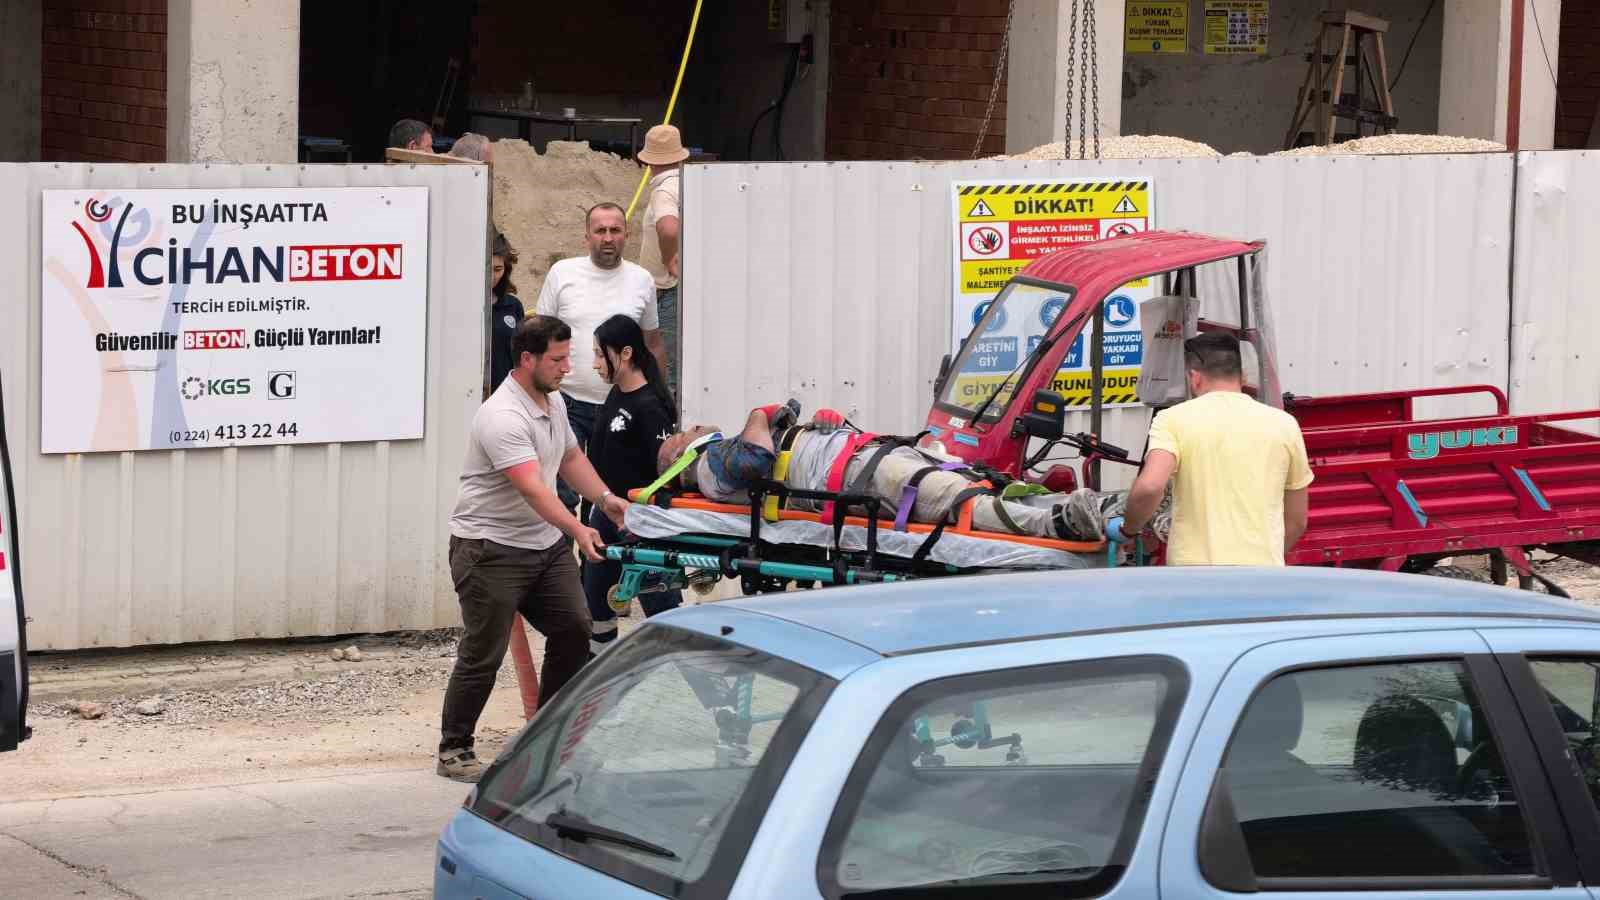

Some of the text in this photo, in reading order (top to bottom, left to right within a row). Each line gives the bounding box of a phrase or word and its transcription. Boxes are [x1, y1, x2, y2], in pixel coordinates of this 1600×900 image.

[1014, 197, 1094, 214] DİKKAT!
[172, 198, 328, 230] BU İNŞAATTA
[1017, 223, 1094, 235] İNŞAATA İZİNSİZ
[1011, 233, 1100, 245] GİRMEK TEHLİKELİ
[133, 237, 402, 286] CİHAN BETON
[978, 266, 1013, 276] ŞANTİYE
[966, 279, 1009, 289] MALZEME
[173, 298, 311, 315] TERCİH EDİLMİŞTİR.
[95, 331, 178, 352] Güvenilir
[254, 327, 304, 350] Güçlü
[309, 325, 381, 346] Yarınlar!
[1102, 333, 1142, 343] ORUYUCU
[1102, 344, 1139, 354] YAKKABI
[978, 352, 999, 367] GİY
[1109, 353, 1125, 364] GİY
[207, 373, 293, 397] KGS G
[168, 422, 299, 443] (0 224) 413 22 44
